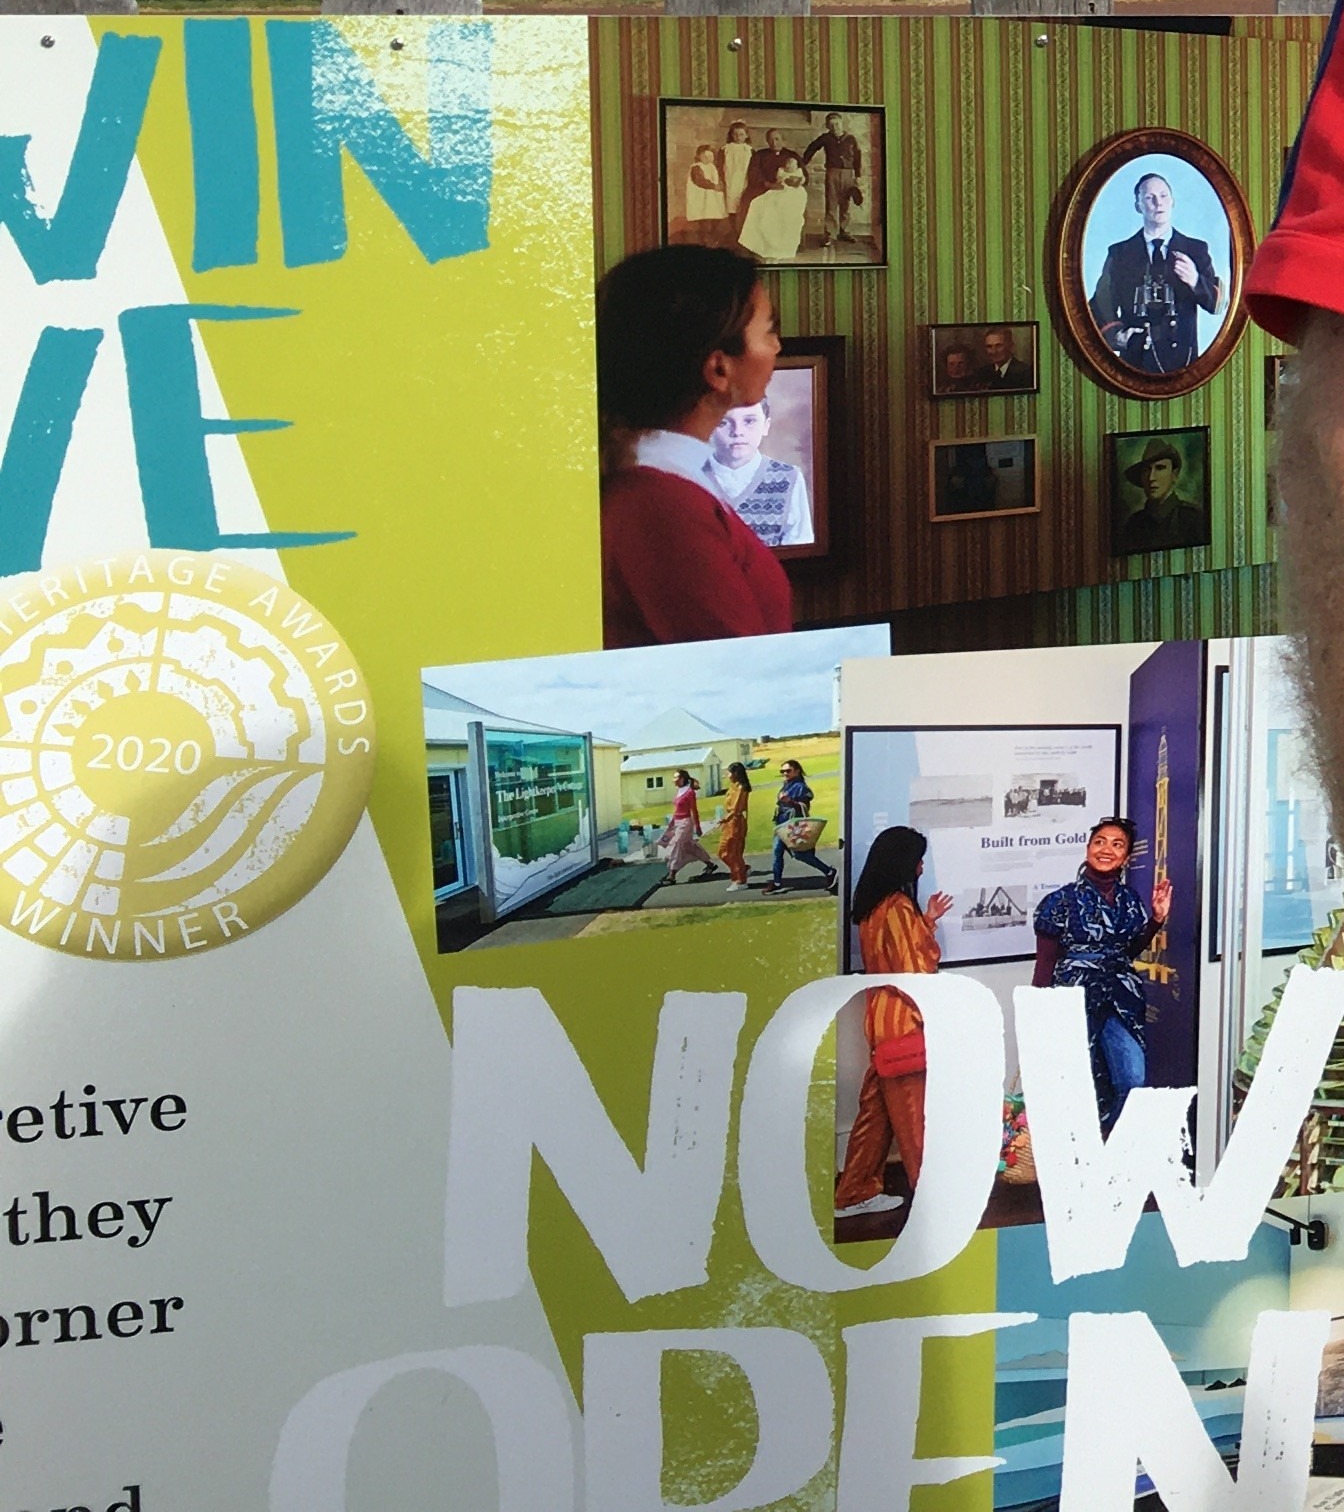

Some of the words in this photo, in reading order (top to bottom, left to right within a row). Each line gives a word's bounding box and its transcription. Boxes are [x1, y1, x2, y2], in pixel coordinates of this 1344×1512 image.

[248, 585, 370, 756] AWARDS
[86, 734, 202, 776] 2020
[980, 836, 1014, 849] Built
[1018, 835, 1051, 847] from
[1055, 832, 1087, 845] Gold
[10, 890, 250, 957] WINNER
[0, 1084, 188, 1144] etive
[2, 1190, 174, 1249] they
[0, 1296, 185, 1349] rner
